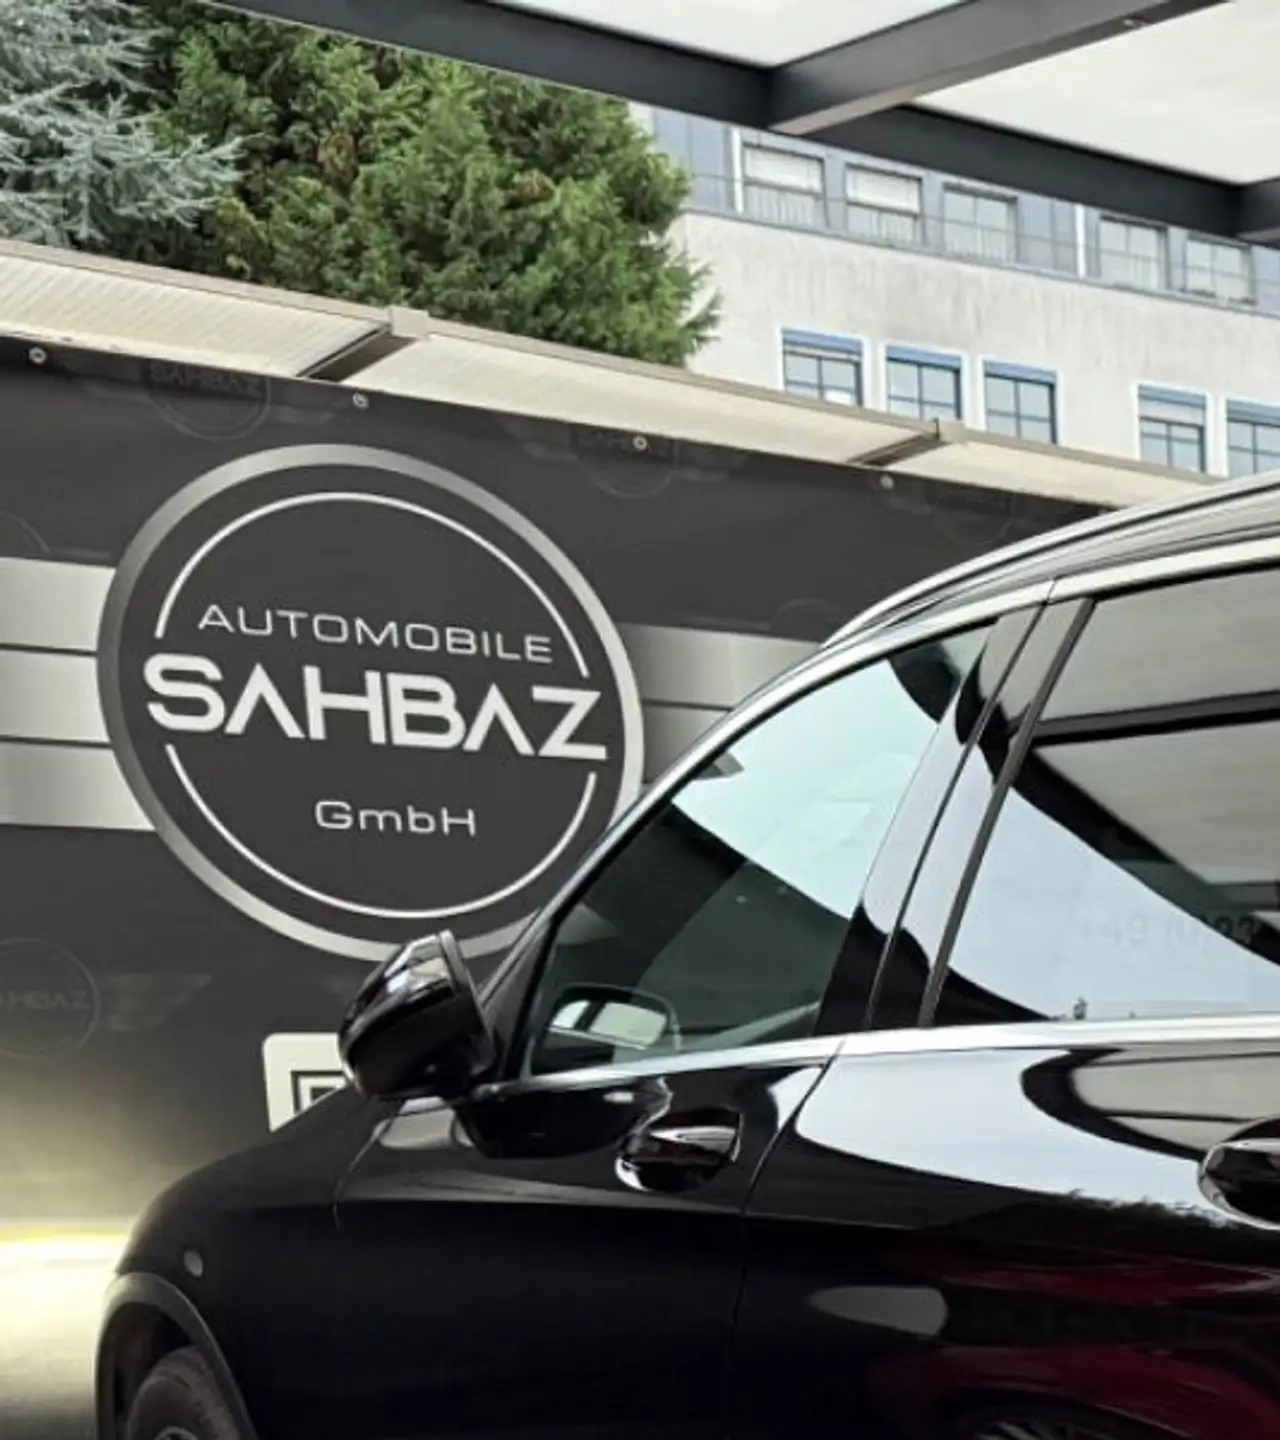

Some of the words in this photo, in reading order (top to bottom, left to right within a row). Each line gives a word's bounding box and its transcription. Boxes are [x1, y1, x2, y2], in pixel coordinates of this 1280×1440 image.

[197, 604, 553, 664] AUTOMOBILE
[143, 652, 608, 761] SAHBAZ
[314, 799, 476, 837] GmbH
